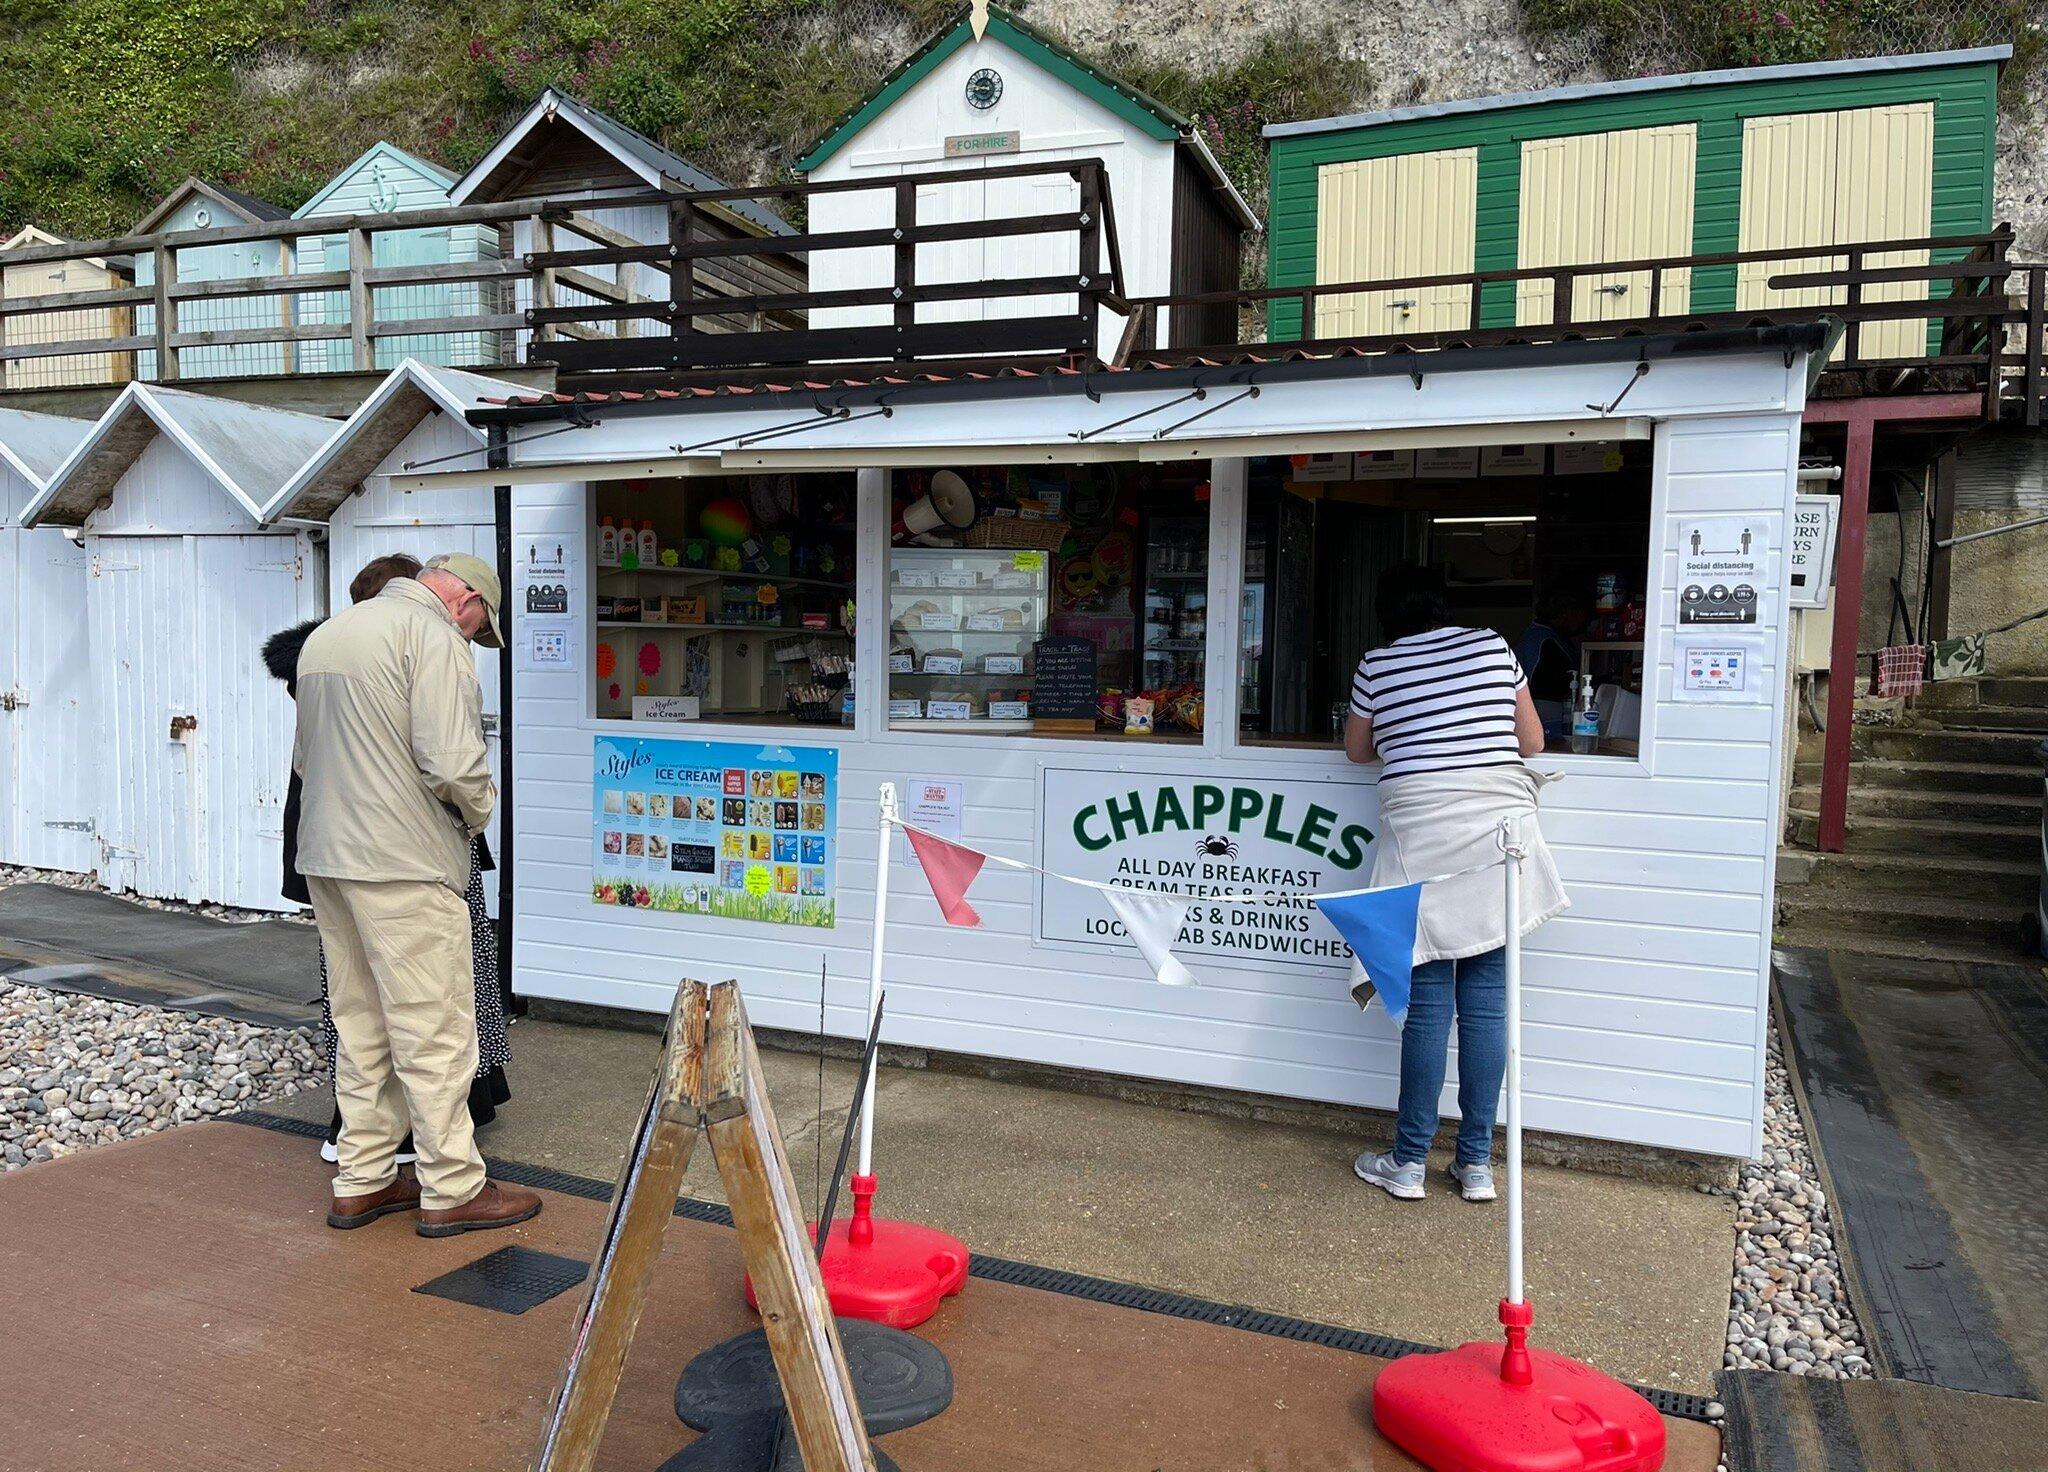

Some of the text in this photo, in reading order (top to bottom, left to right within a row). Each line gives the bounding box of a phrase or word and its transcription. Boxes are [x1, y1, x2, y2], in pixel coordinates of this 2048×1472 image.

[957, 137, 1008, 150] FOR HIRE
[1686, 561, 1754, 571] Social distancing
[659, 710, 686, 718] Cream
[601, 748, 652, 780] Styles
[655, 768, 721, 783] ICE CREAM
[1072, 784, 1376, 871] CHAPPLES
[1117, 857, 1321, 888] ALL DAY BREAKFAST
[1209, 907, 1224, 925] &
[1231, 910, 1309, 932] DRINKS
[1174, 927, 1204, 944] AB
[1211, 930, 1354, 959] SANDWICHES
